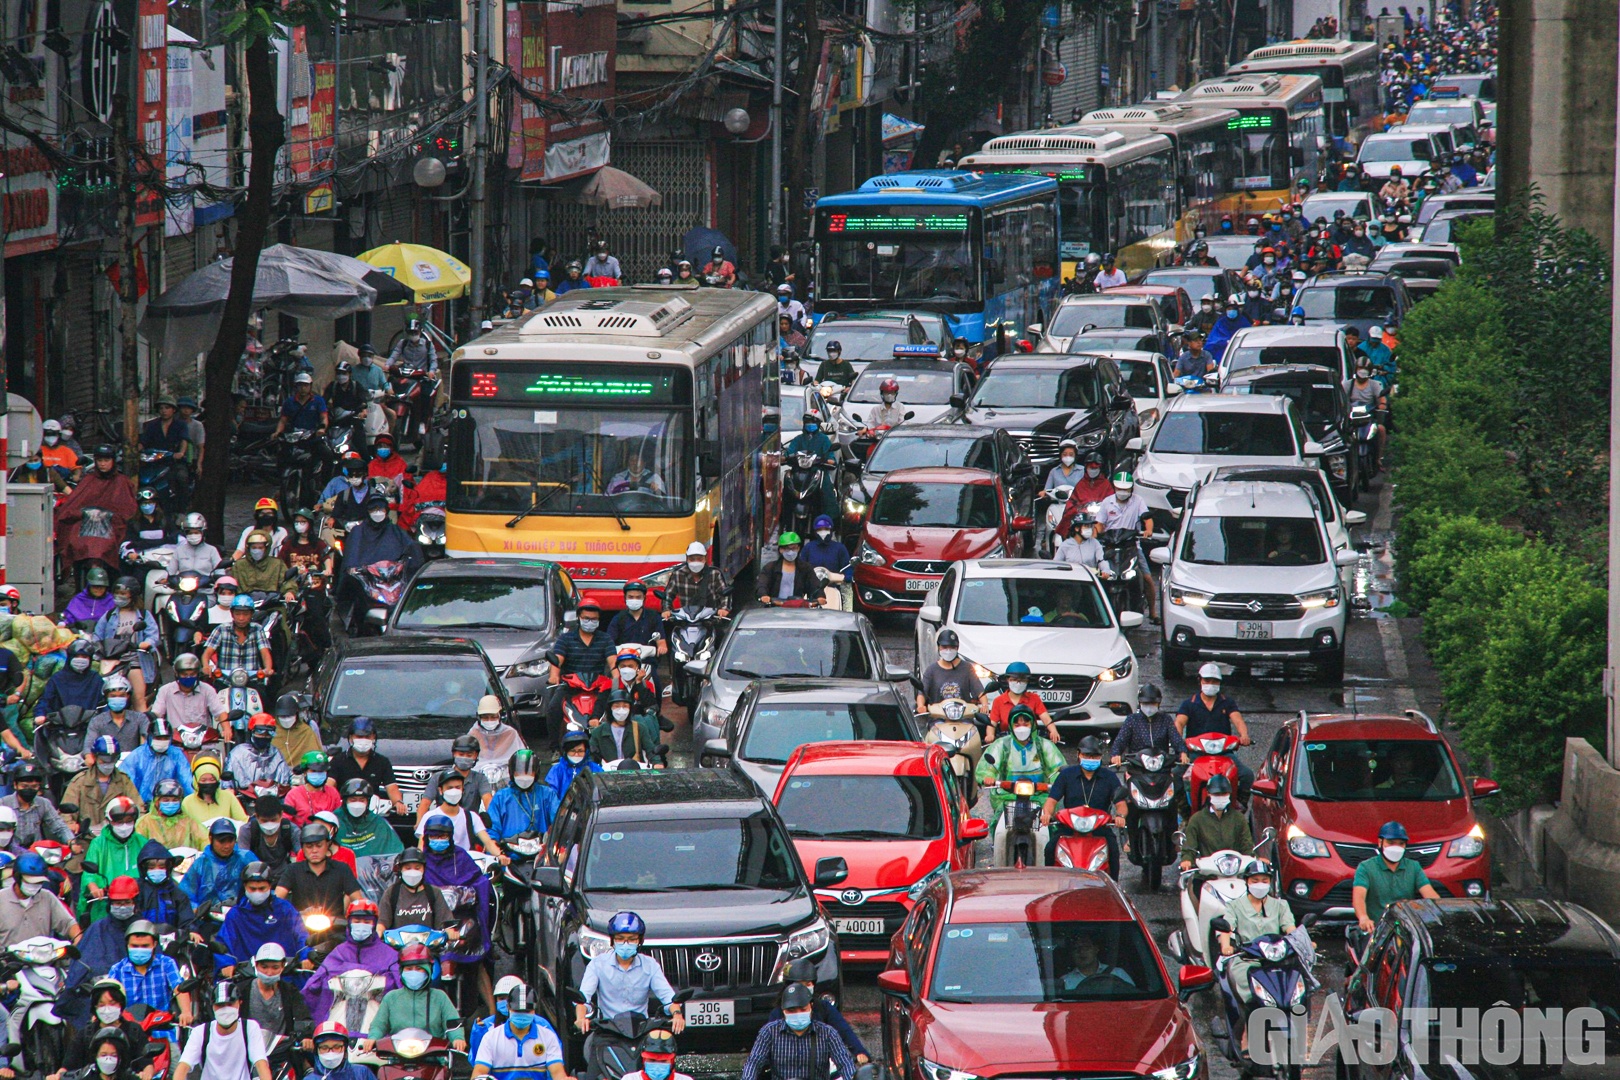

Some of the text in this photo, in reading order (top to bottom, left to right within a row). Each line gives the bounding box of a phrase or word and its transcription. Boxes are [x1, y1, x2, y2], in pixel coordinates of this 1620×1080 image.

[559, 541, 577, 551] BUS
[1247, 622, 1263, 631] 30H
[1240, 630, 1269, 639] 777.82
[699, 1002, 720, 1013] 30G
[690, 1013, 730, 1025] 583.36
